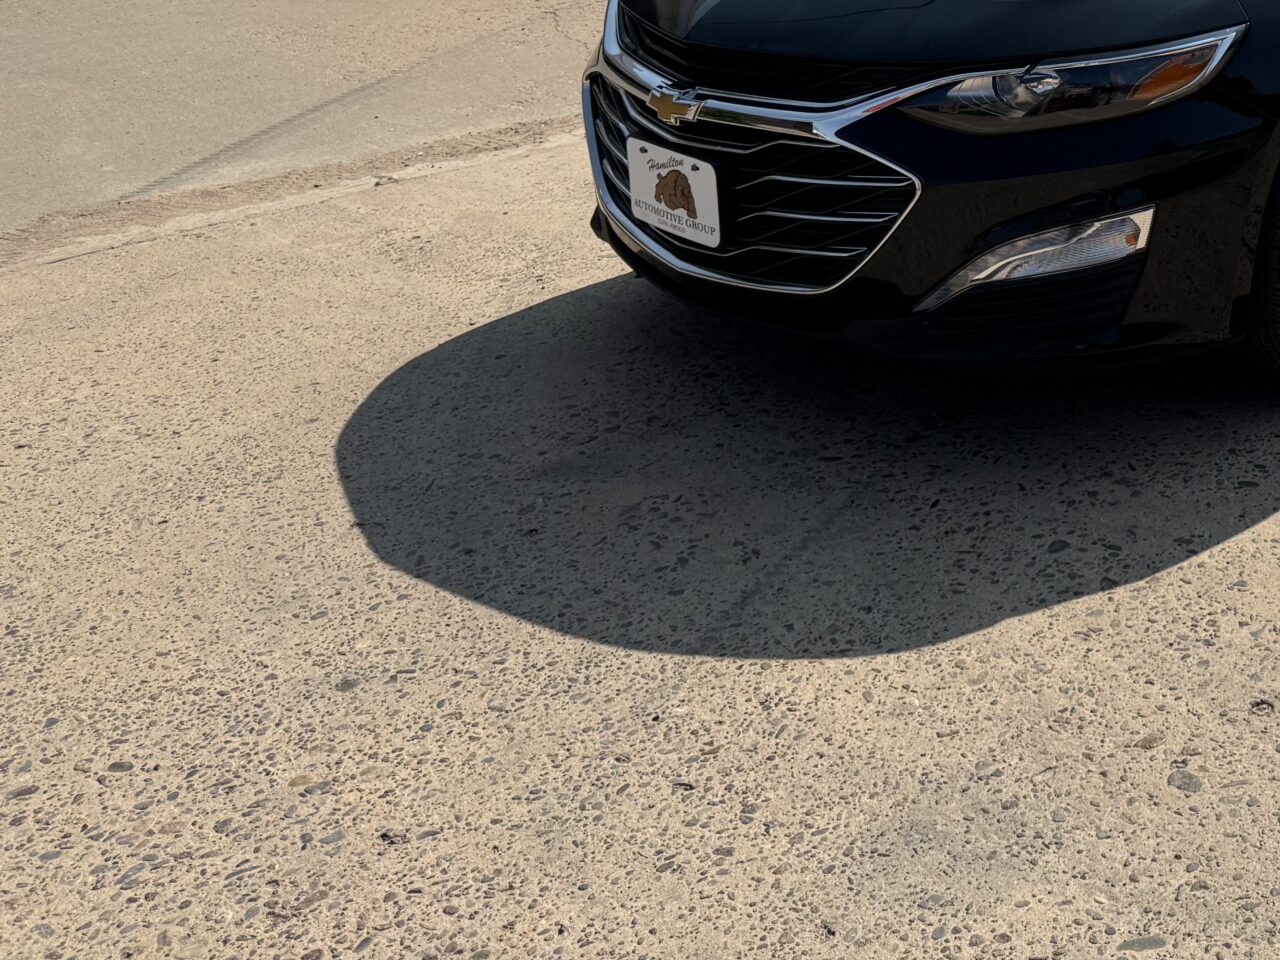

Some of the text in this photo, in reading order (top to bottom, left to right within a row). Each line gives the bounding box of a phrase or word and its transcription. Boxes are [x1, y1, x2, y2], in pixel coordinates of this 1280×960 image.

[646, 156, 684, 172] Hamilton
[634, 198, 683, 225] AUTOMOTIVE
[685, 216, 716, 236] GROUP
